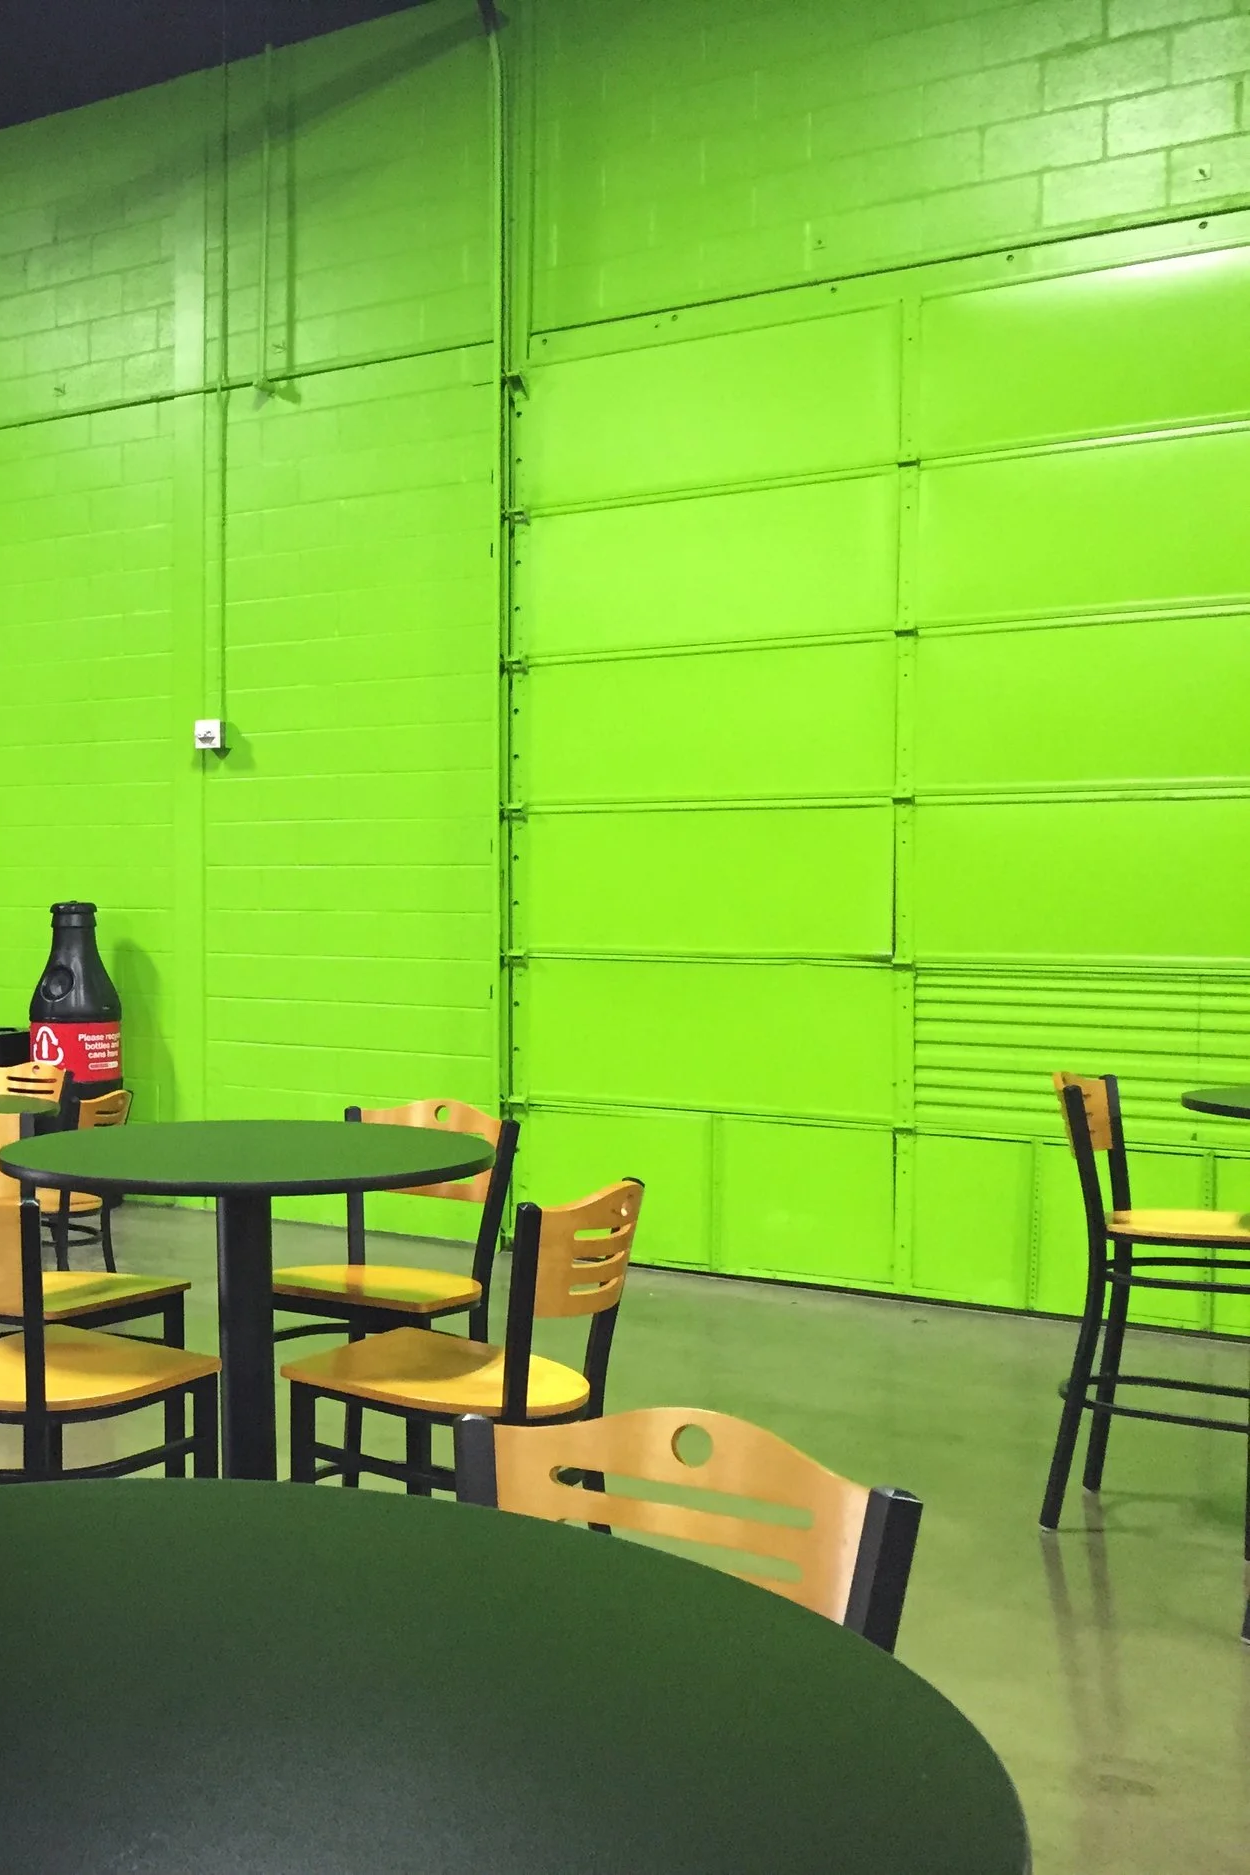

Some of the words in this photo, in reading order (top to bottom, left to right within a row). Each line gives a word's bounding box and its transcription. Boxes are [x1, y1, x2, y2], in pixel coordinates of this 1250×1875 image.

[78, 1034, 104, 1042] Please
[85, 1041, 110, 1050] bottles
[88, 1051, 106, 1059] cans
